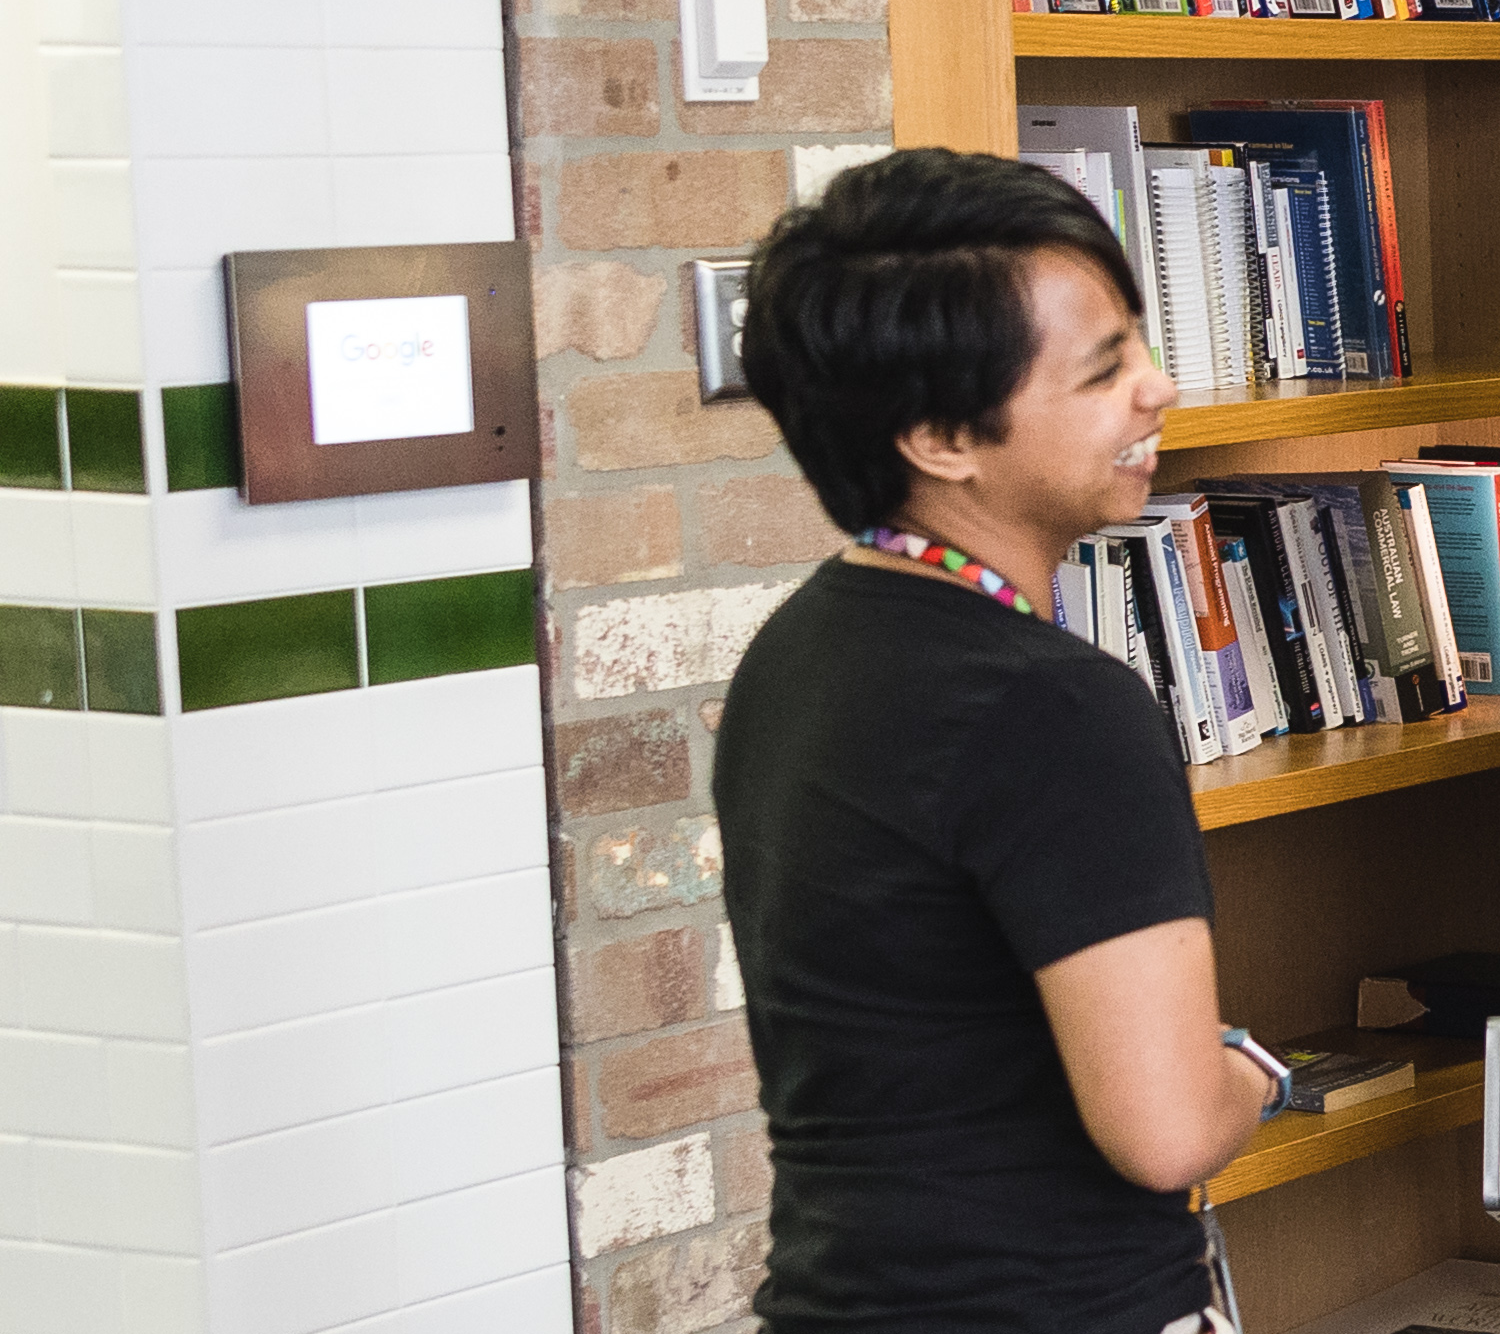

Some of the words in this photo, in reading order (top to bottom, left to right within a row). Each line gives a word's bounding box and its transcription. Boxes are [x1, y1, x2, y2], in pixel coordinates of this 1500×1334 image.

[341, 334, 435, 366] Google
[1204, 523, 1218, 563] Android
[1212, 562, 1230, 627] Programming
[1373, 511, 1397, 592] COMMERCIAL
[1388, 592, 1402, 619] LAW
[1380, 508, 1405, 585] AUSTRALIAN
